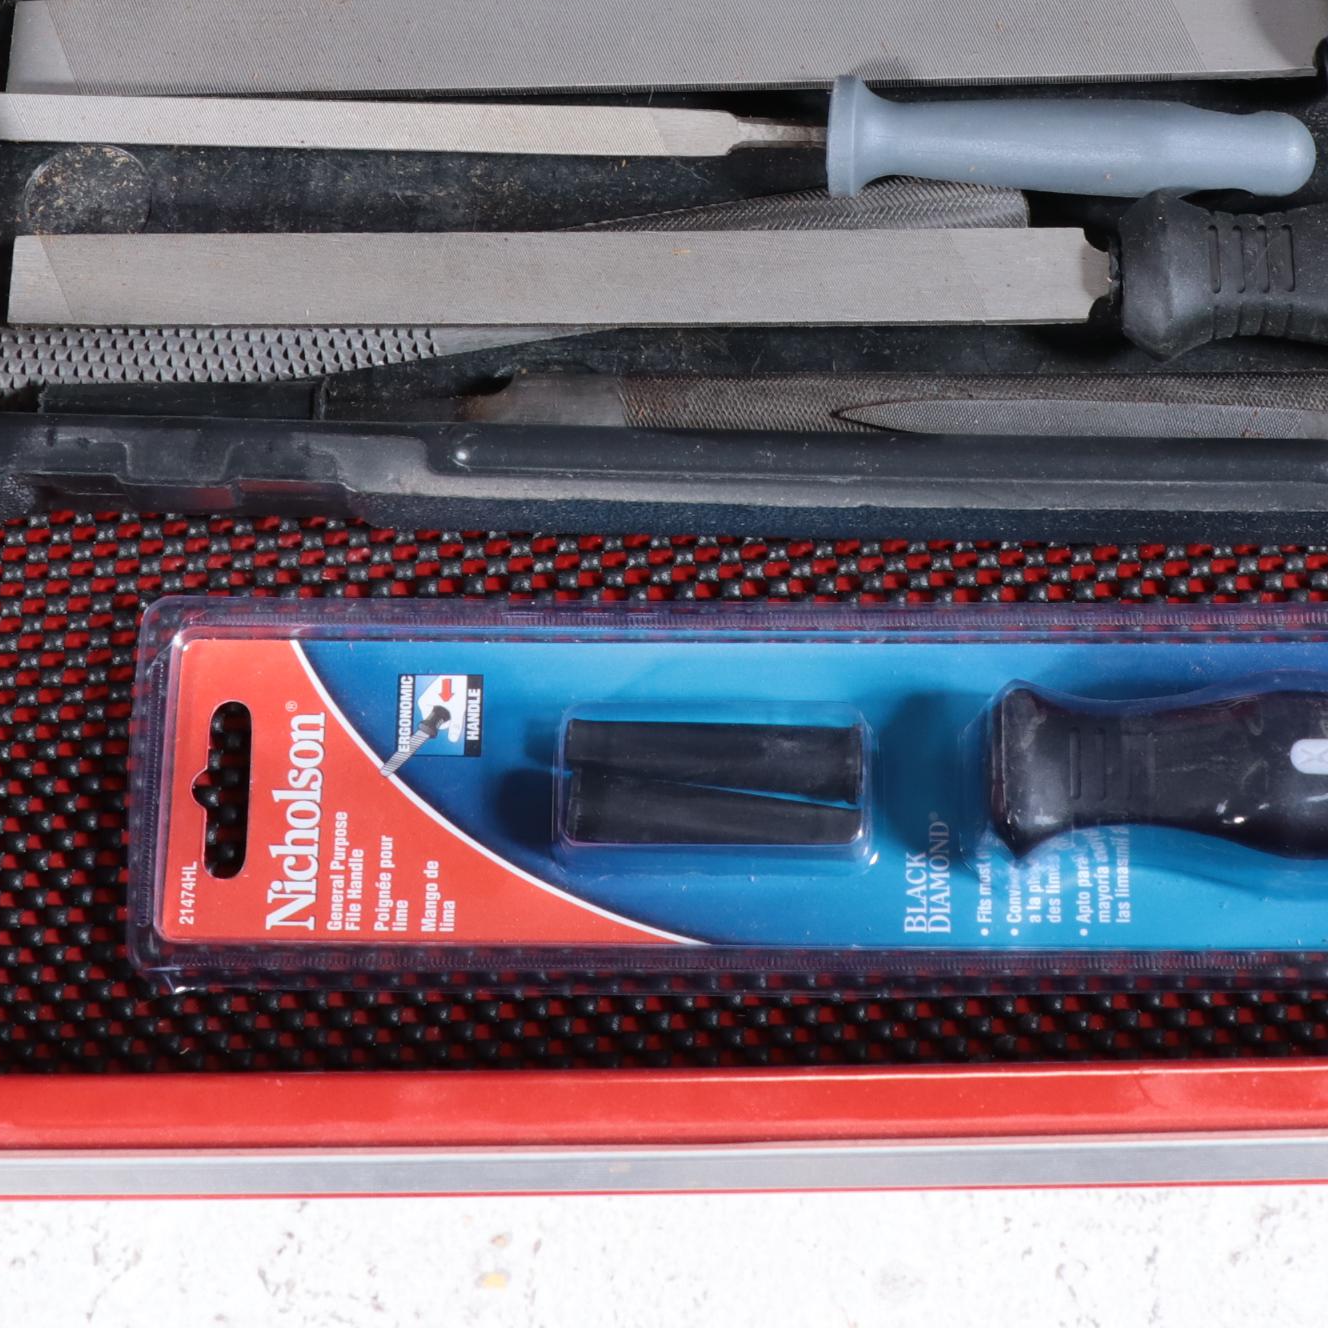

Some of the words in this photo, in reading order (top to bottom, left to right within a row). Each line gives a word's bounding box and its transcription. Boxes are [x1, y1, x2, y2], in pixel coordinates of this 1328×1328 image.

[397, 675, 414, 753] ERGONOMIC
[466, 688, 481, 741] HANDLE
[265, 711, 325, 931] Nicholson
[329, 811, 350, 870] Purpose
[380, 835, 396, 868] pour
[423, 860, 440, 879] de
[178, 860, 197, 925] 21474HL
[346, 848, 364, 899] Handle
[903, 851, 928, 934] BLACK
[927, 820, 952, 934] DIAMOND
[975, 862, 992, 895] most
[1114, 858, 1130, 898] limas
[326, 874, 346, 931] General
[373, 872, 394, 931] Poignée
[420, 883, 441, 932] Mango
[976, 898, 992, 923] Fits
[1026, 896, 1042, 910] la
[1045, 898, 1062, 923] des
[1075, 891, 1094, 924] Apto
[1093, 866, 1114, 923] mayoría
[1115, 900, 1131, 923] las
[344, 903, 362, 931] File
[392, 899, 409, 931] lime
[438, 900, 456, 932] lima
[1029, 914, 1042, 923] a
